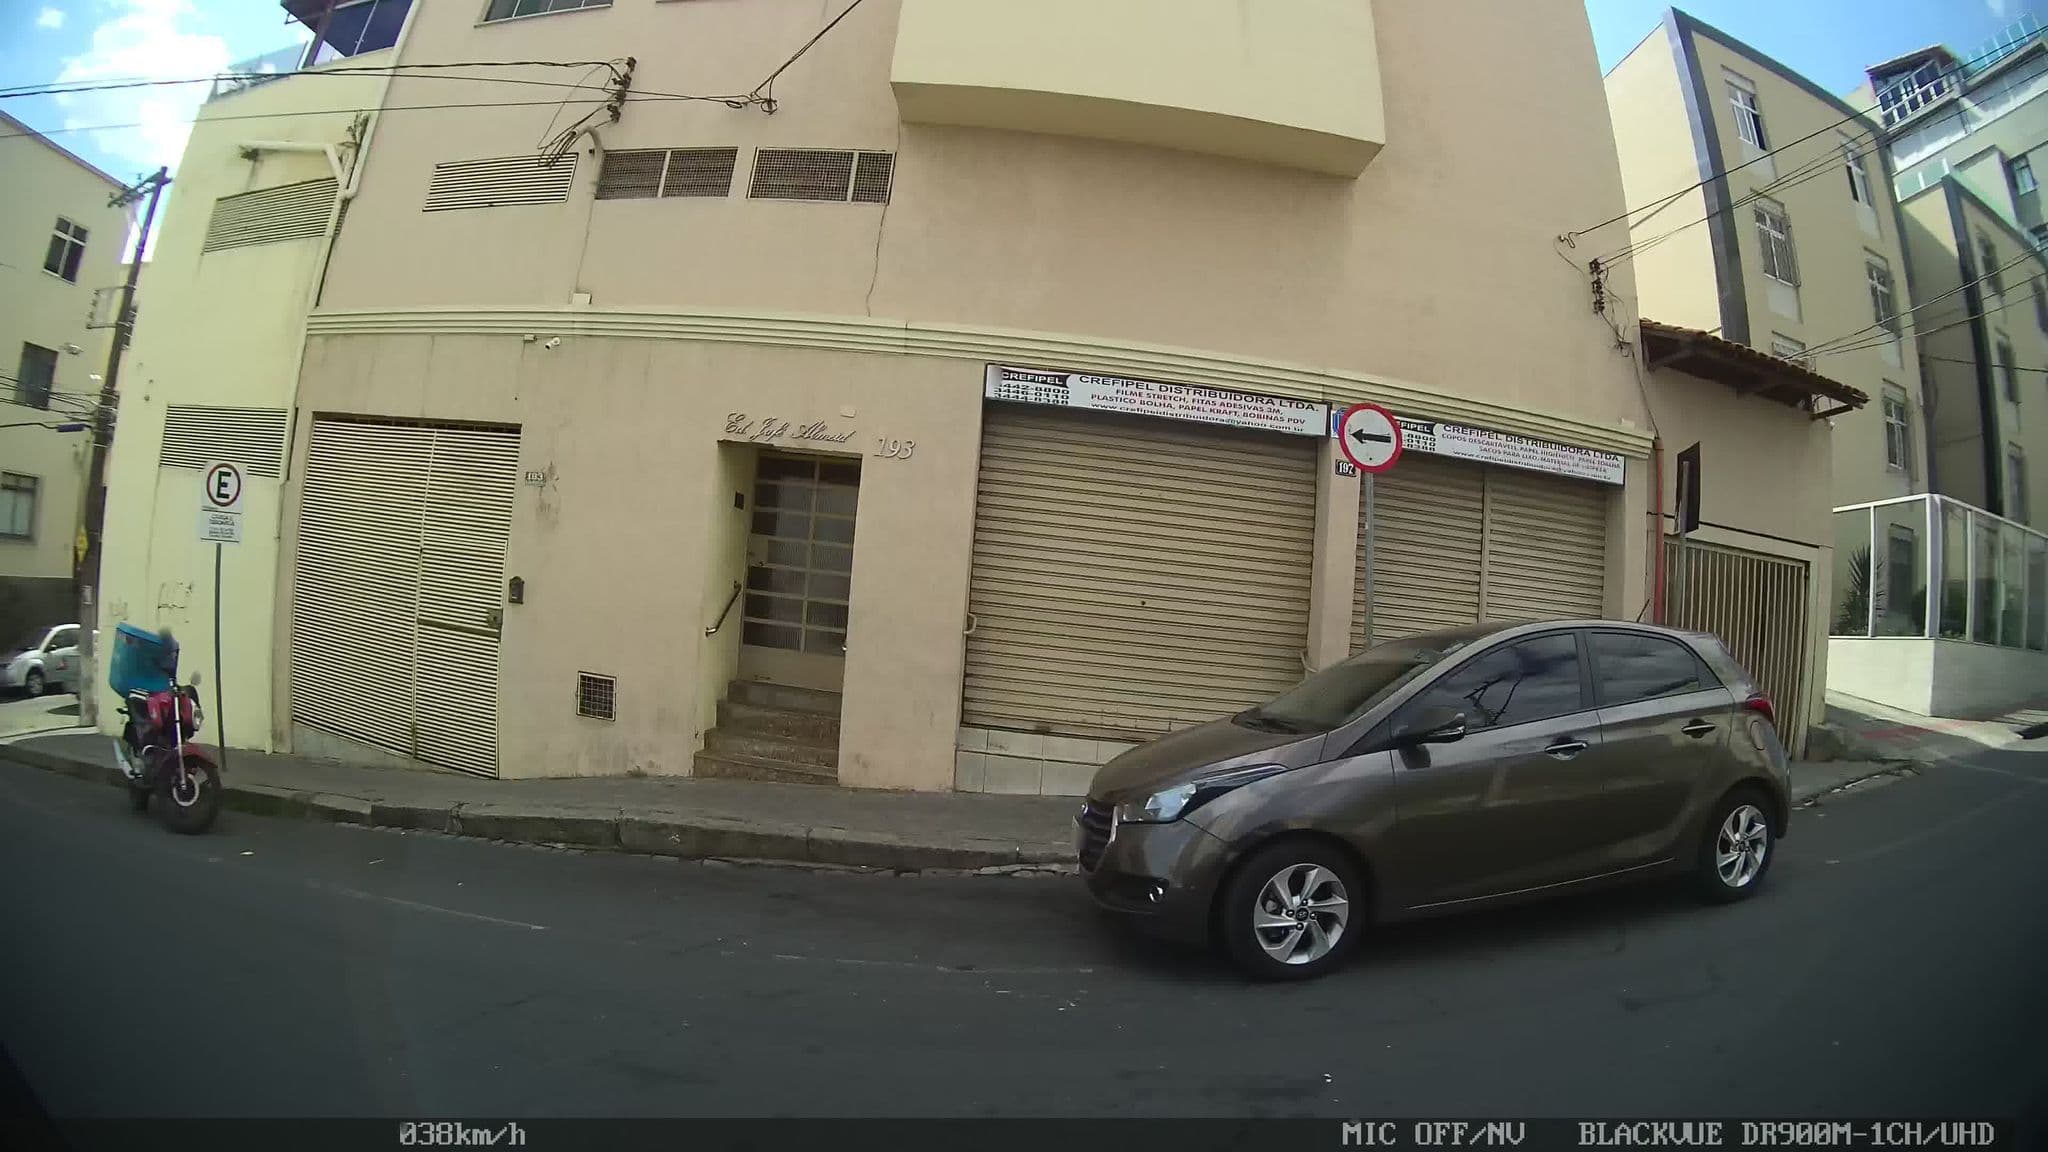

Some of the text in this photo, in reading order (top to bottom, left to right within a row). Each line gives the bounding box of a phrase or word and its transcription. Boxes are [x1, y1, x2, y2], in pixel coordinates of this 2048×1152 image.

[1002, 372, 1064, 385] CREFIPEL
[1079, 375, 1319, 412] CREFIPEL DISTRIBUIDORA LTDA.
[1116, 389, 1145, 398] FILME
[1146, 391, 1188, 403] STRETCH,
[1191, 398, 1217, 406] FITAS
[1219, 401, 1264, 412] ADESIVAS
[1178, 404, 1209, 413] PAPEL
[1242, 412, 1285, 422] BOBINAS
[1287, 417, 1306, 425] PDV
[873, 437, 916, 459] 193
[1442, 433, 1467, 442] COPOS
[1443, 424, 1502, 440] CREFIPEL
[1505, 434, 1591, 457] DISTRIBUIDORA
[216, 471, 232, 499] E
